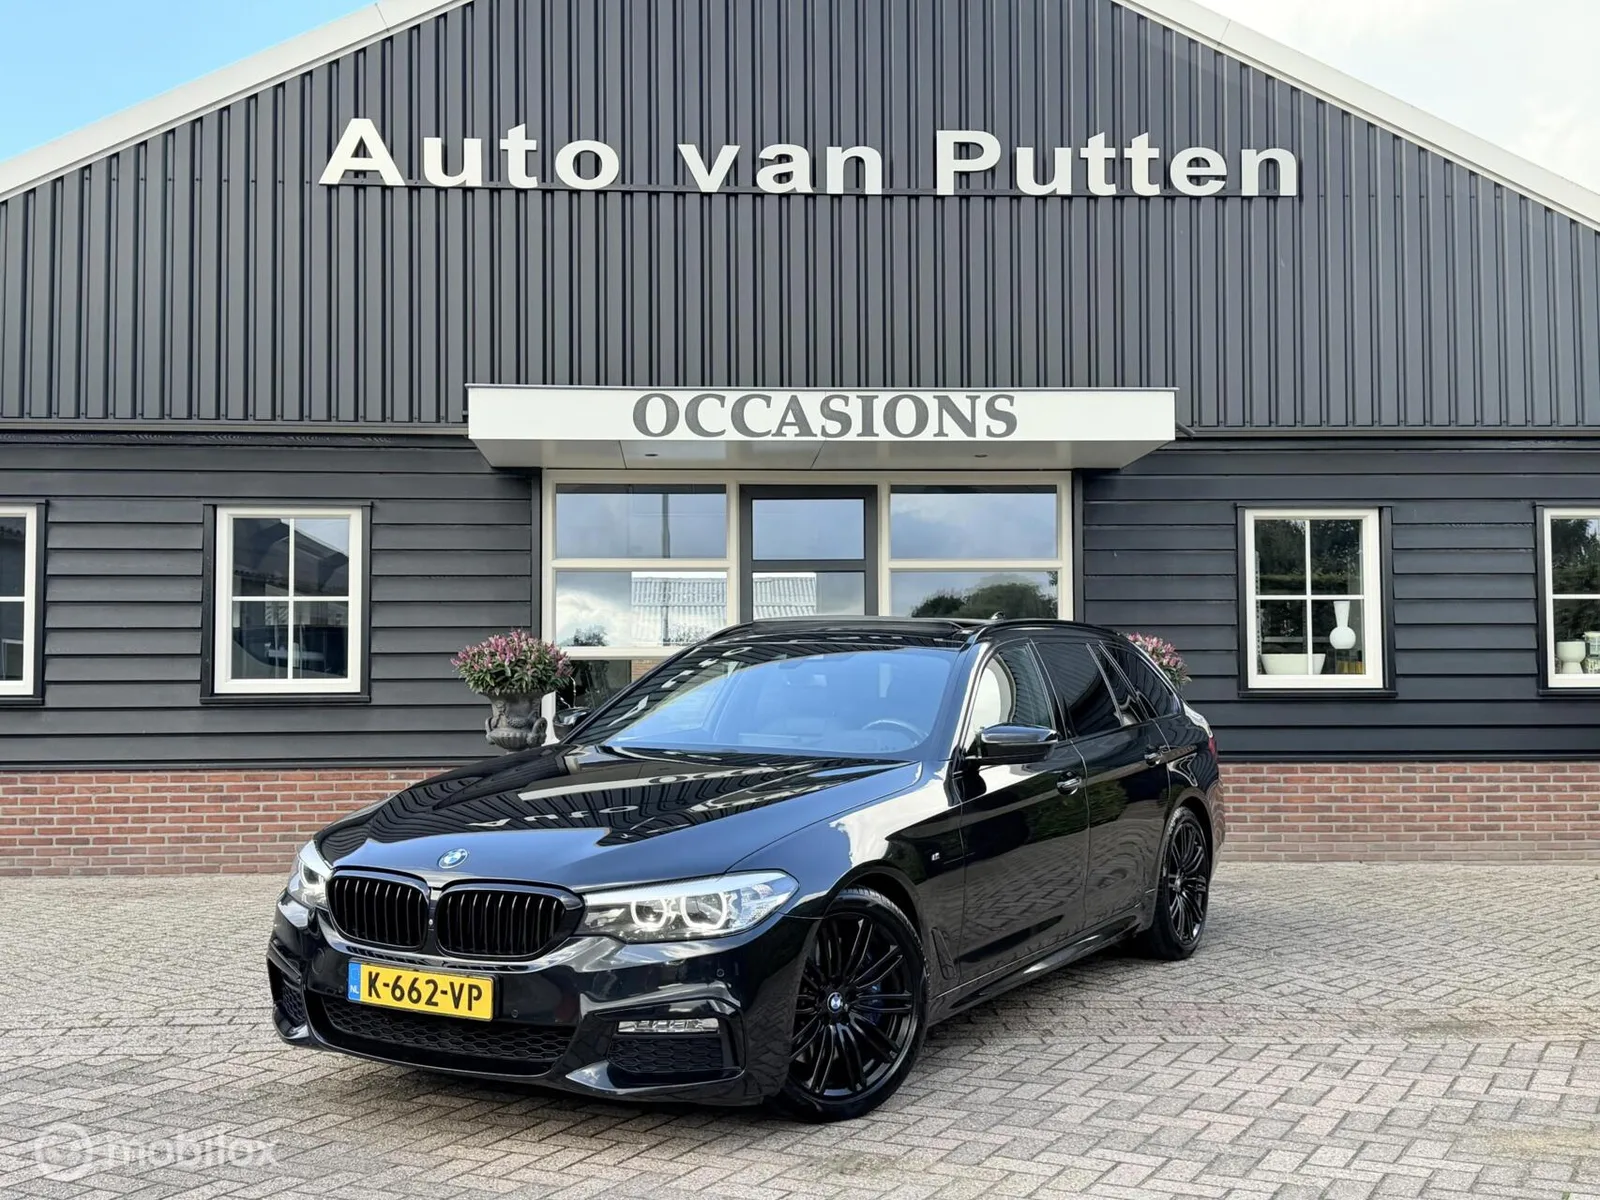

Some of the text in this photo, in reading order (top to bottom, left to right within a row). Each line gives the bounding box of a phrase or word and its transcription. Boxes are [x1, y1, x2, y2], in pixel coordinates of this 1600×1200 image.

[318, 118, 1298, 197] Auto van Putten
[632, 391, 1017, 440] OCCASIONS
[349, 984, 360, 995] NL
[367, 971, 483, 1011] K-662-VP
